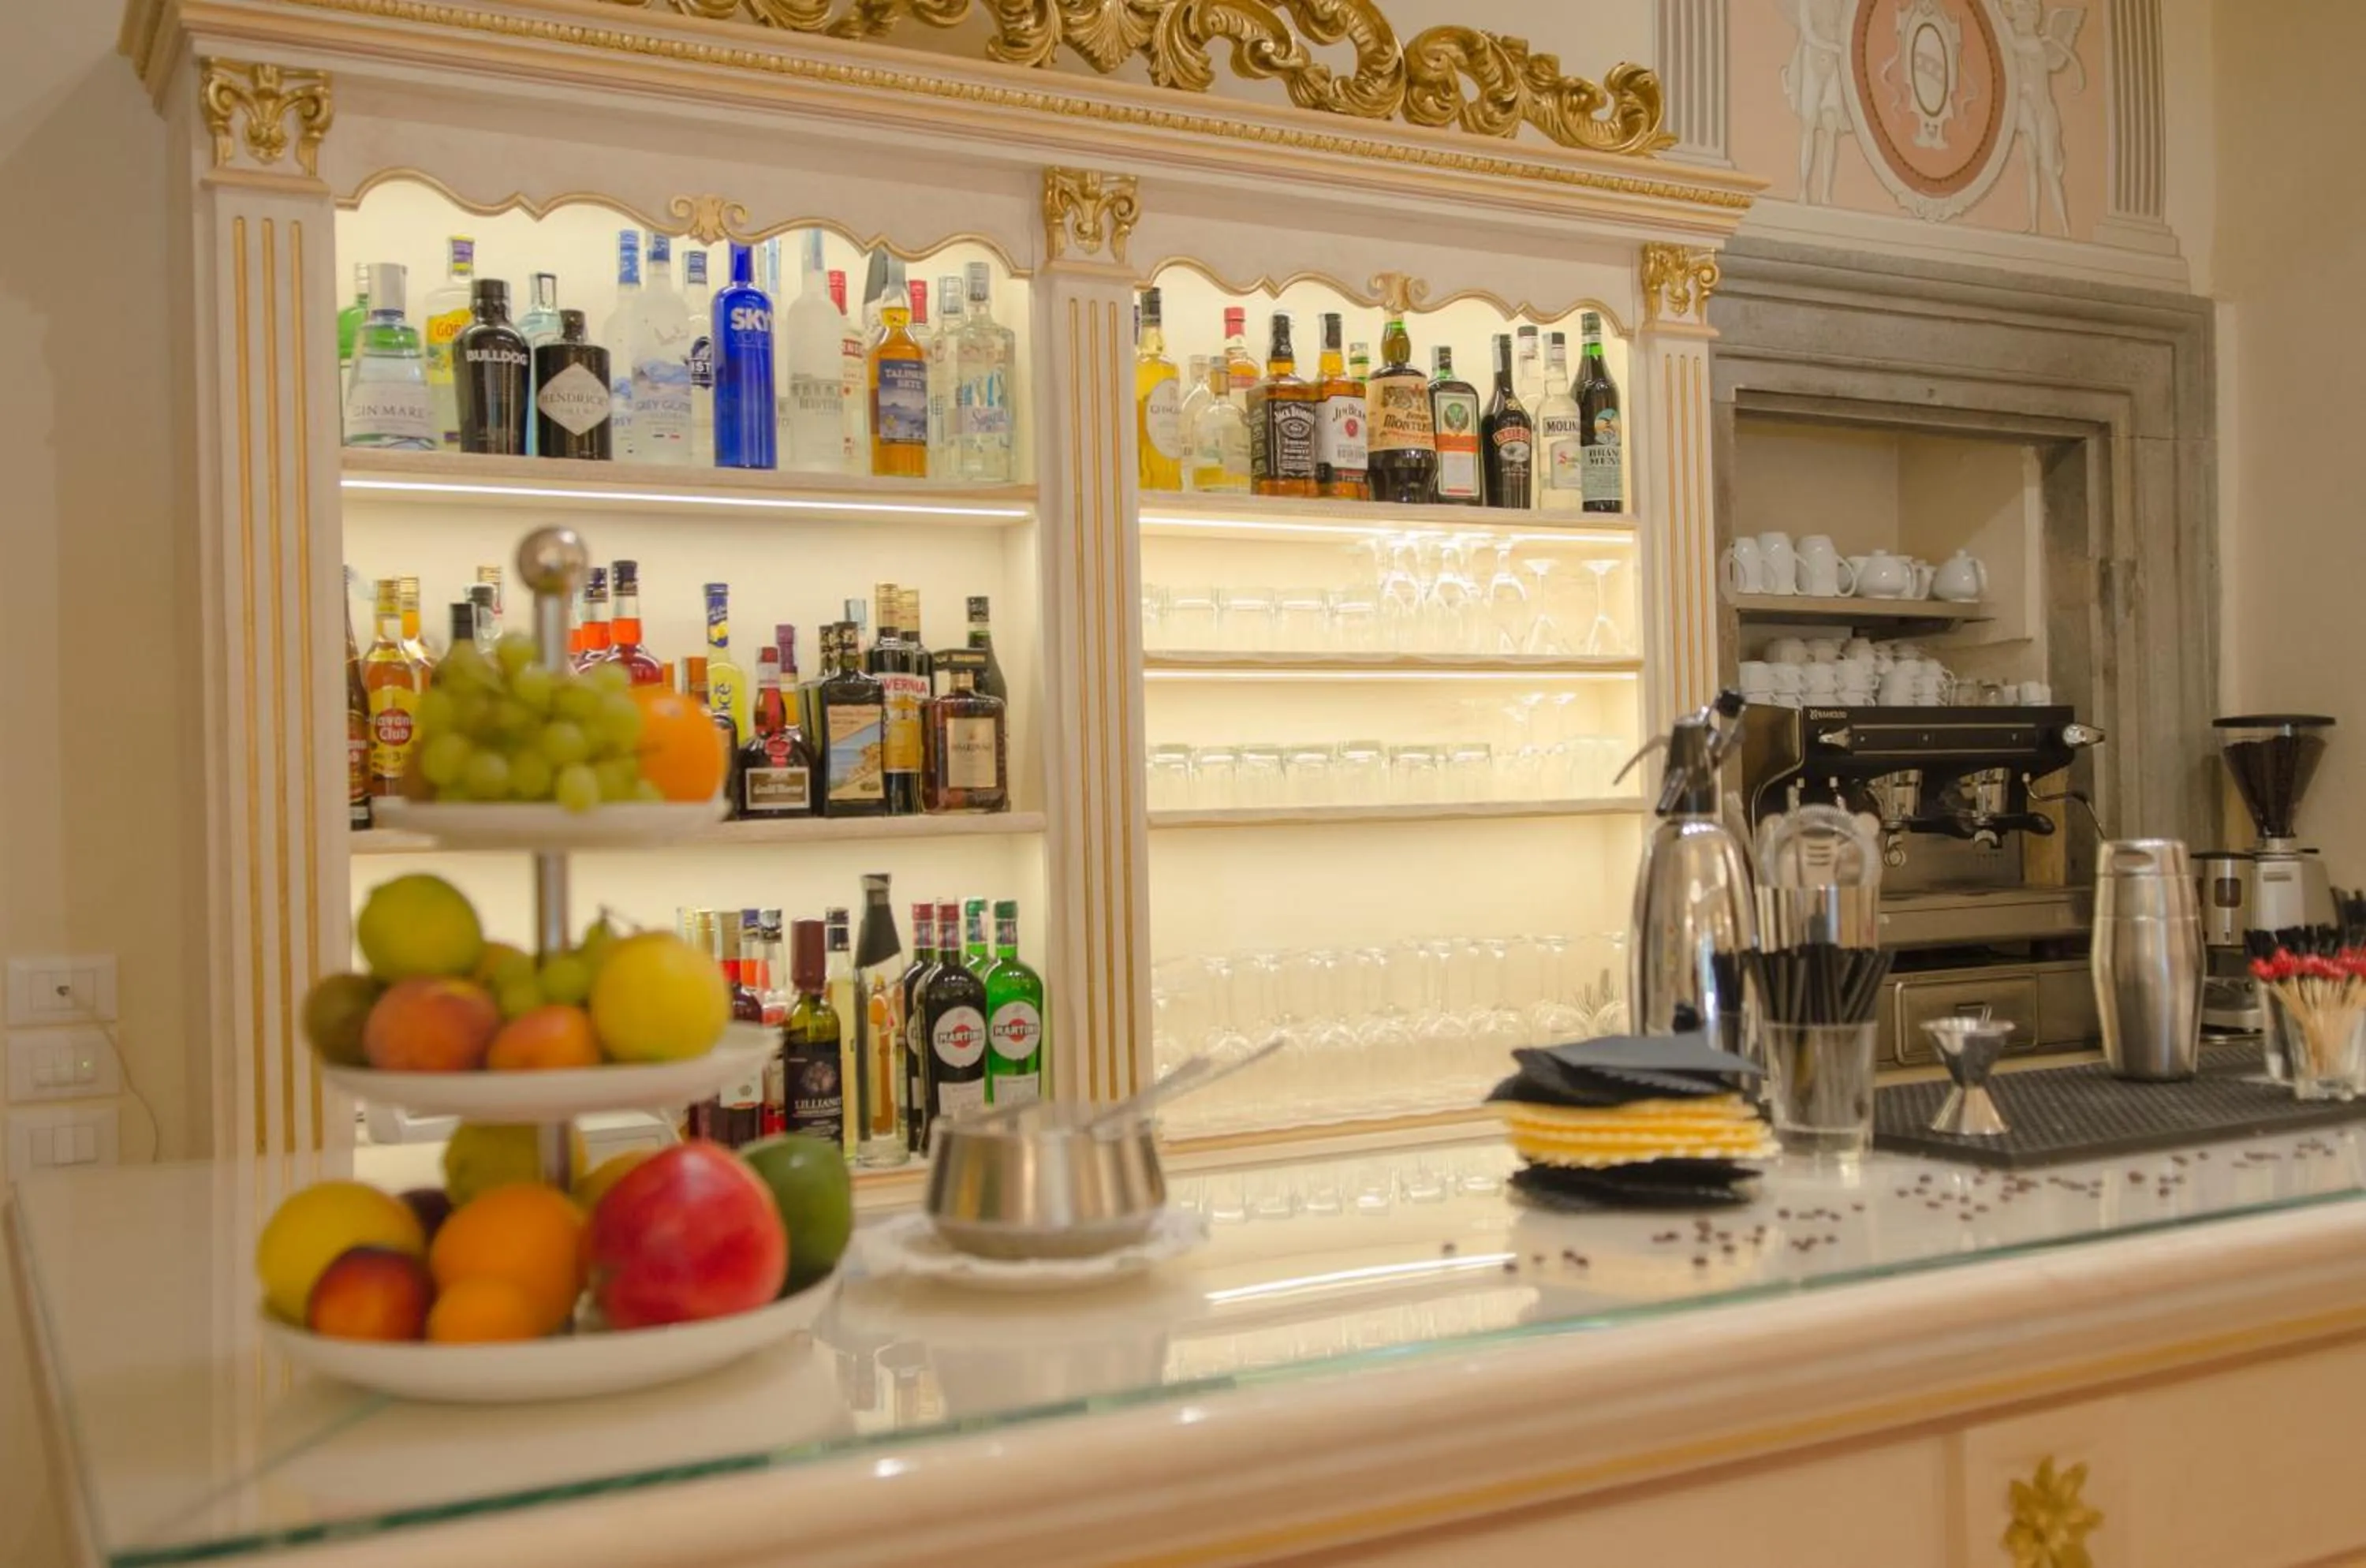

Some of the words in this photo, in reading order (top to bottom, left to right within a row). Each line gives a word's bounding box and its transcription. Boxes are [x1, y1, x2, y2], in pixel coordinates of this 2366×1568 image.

[466, 349, 528, 366] BULLDOG
[379, 727, 409, 740] Club
[937, 1029, 983, 1045] MARTINI
[993, 1023, 1039, 1038] MARTINI
